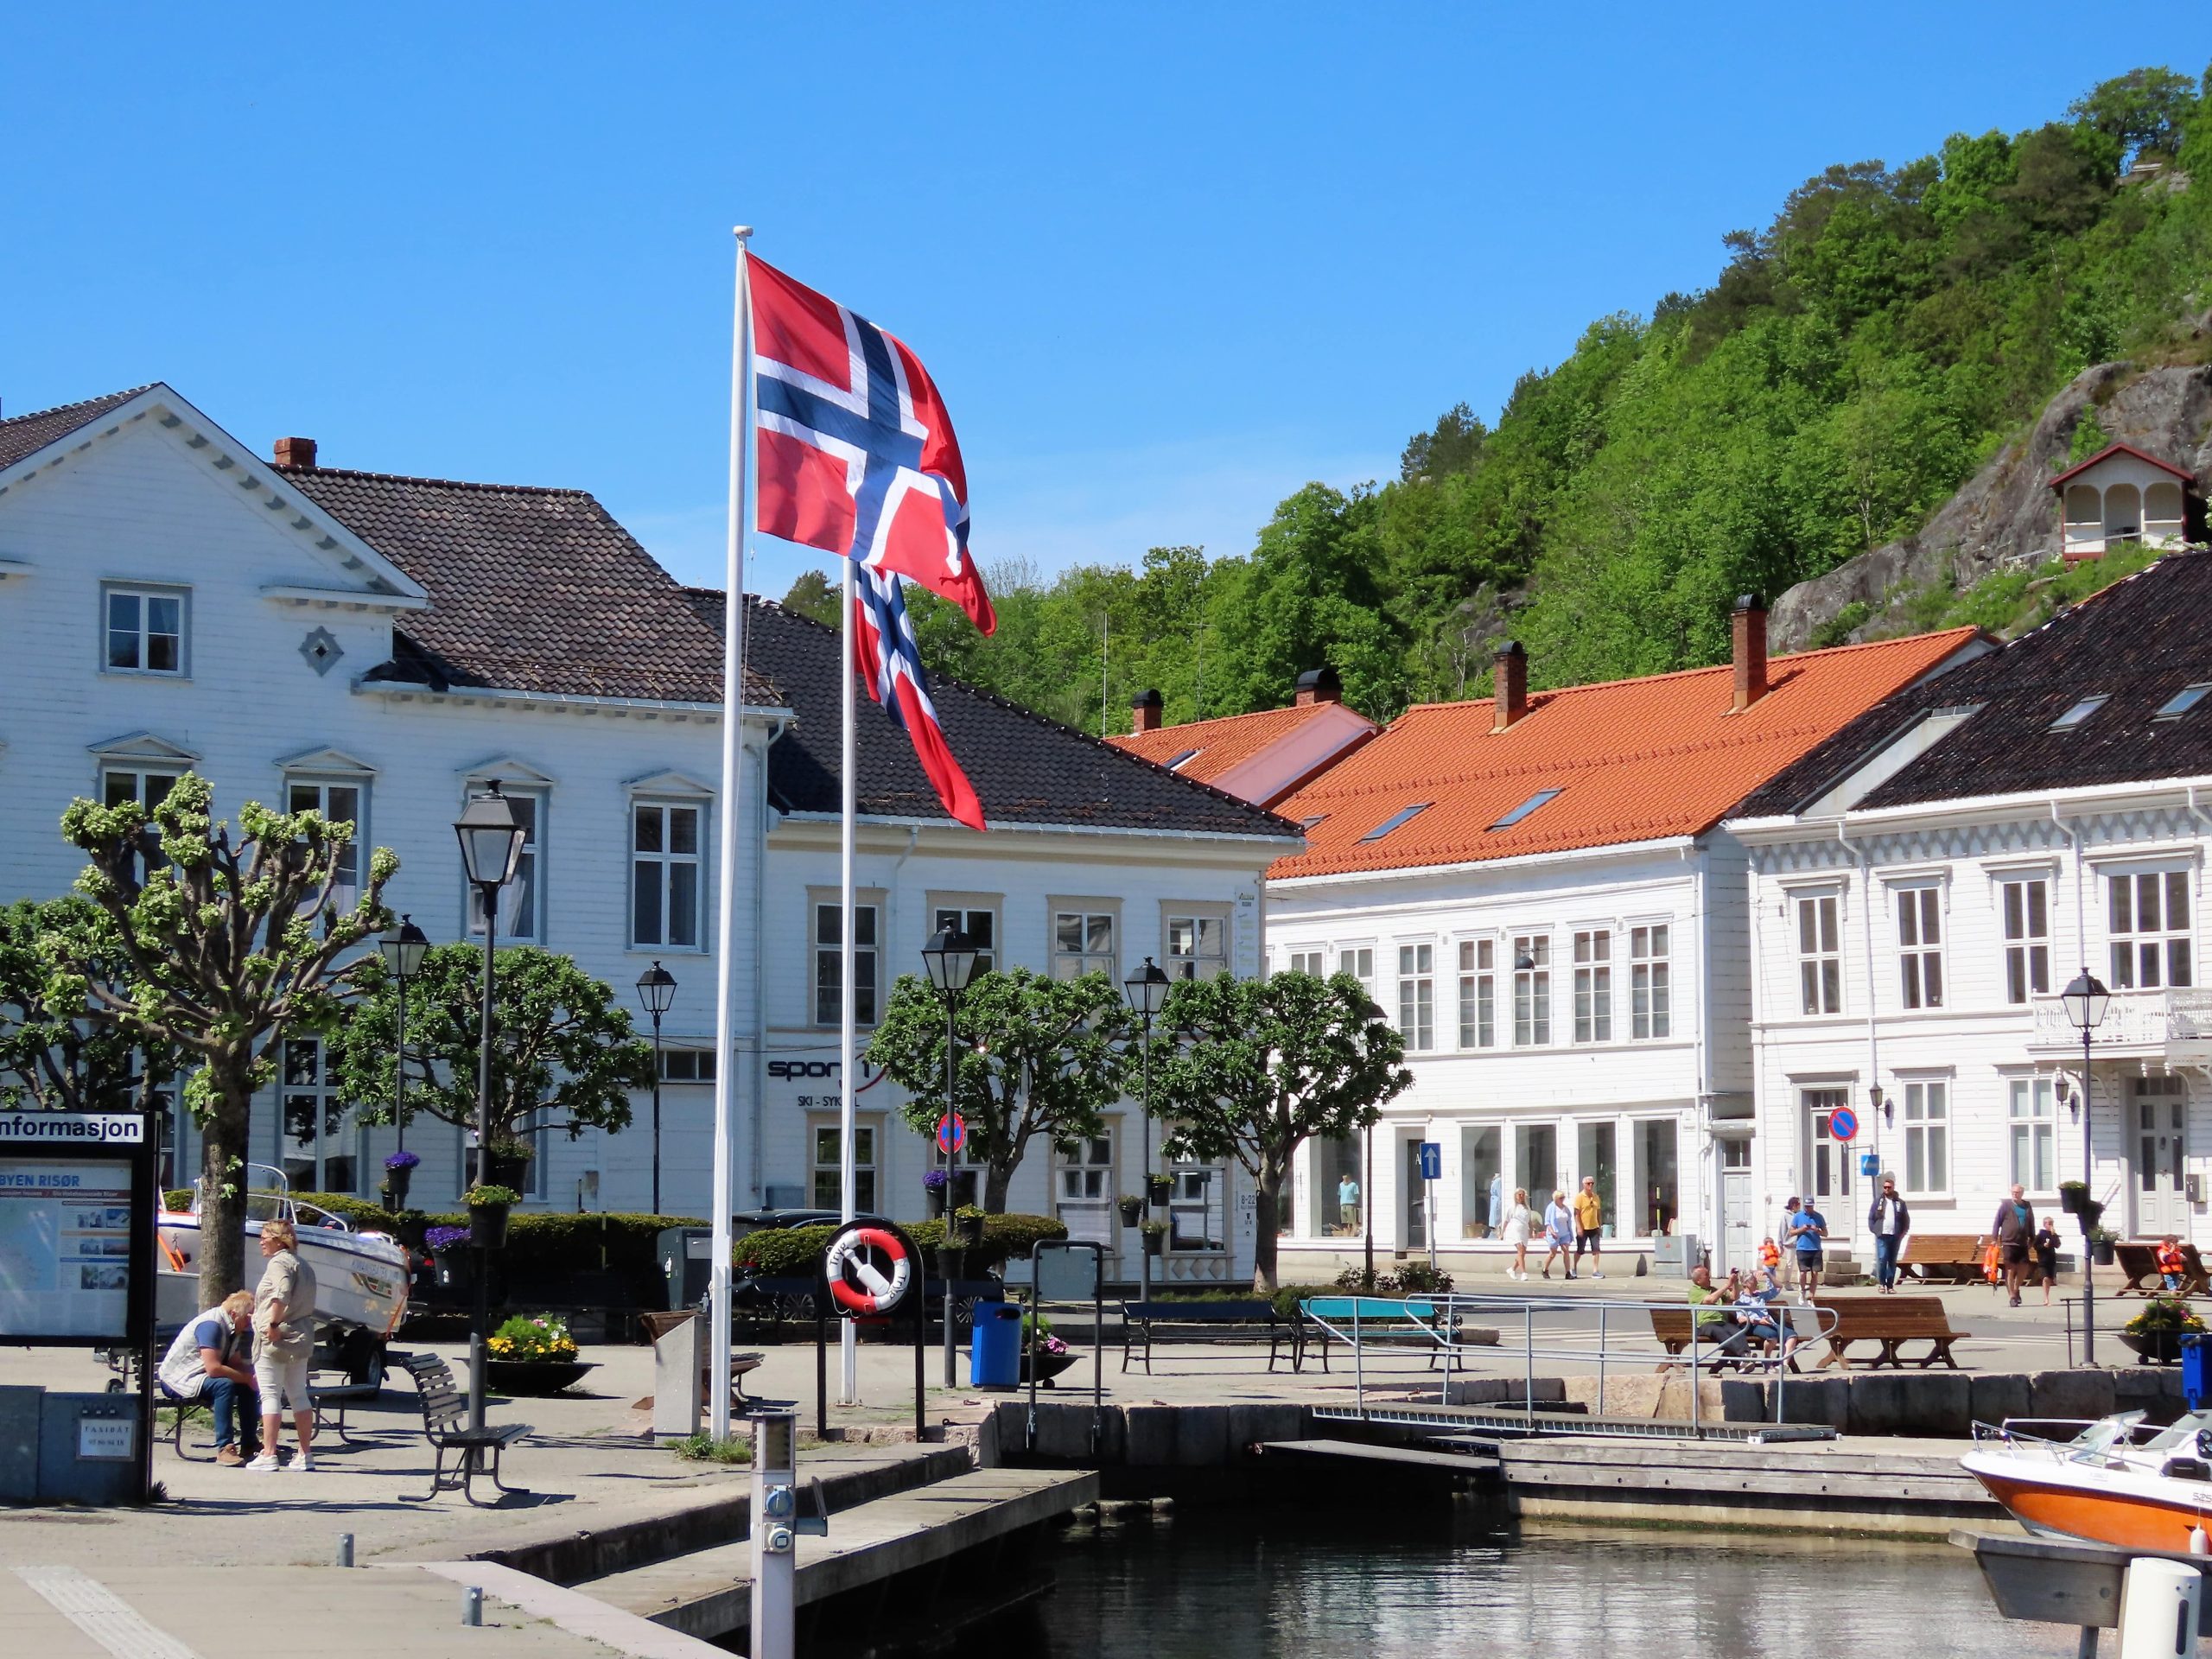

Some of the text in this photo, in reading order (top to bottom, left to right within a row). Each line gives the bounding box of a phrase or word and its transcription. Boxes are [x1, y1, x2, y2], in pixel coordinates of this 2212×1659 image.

[767, 1061, 843, 1082] spor
[798, 1096, 813, 1106] SKI
[823, 1096, 861, 1106] SYKL
[39, 1174, 80, 1187] RISØR
[1241, 1194, 1255, 1205] 8-22
